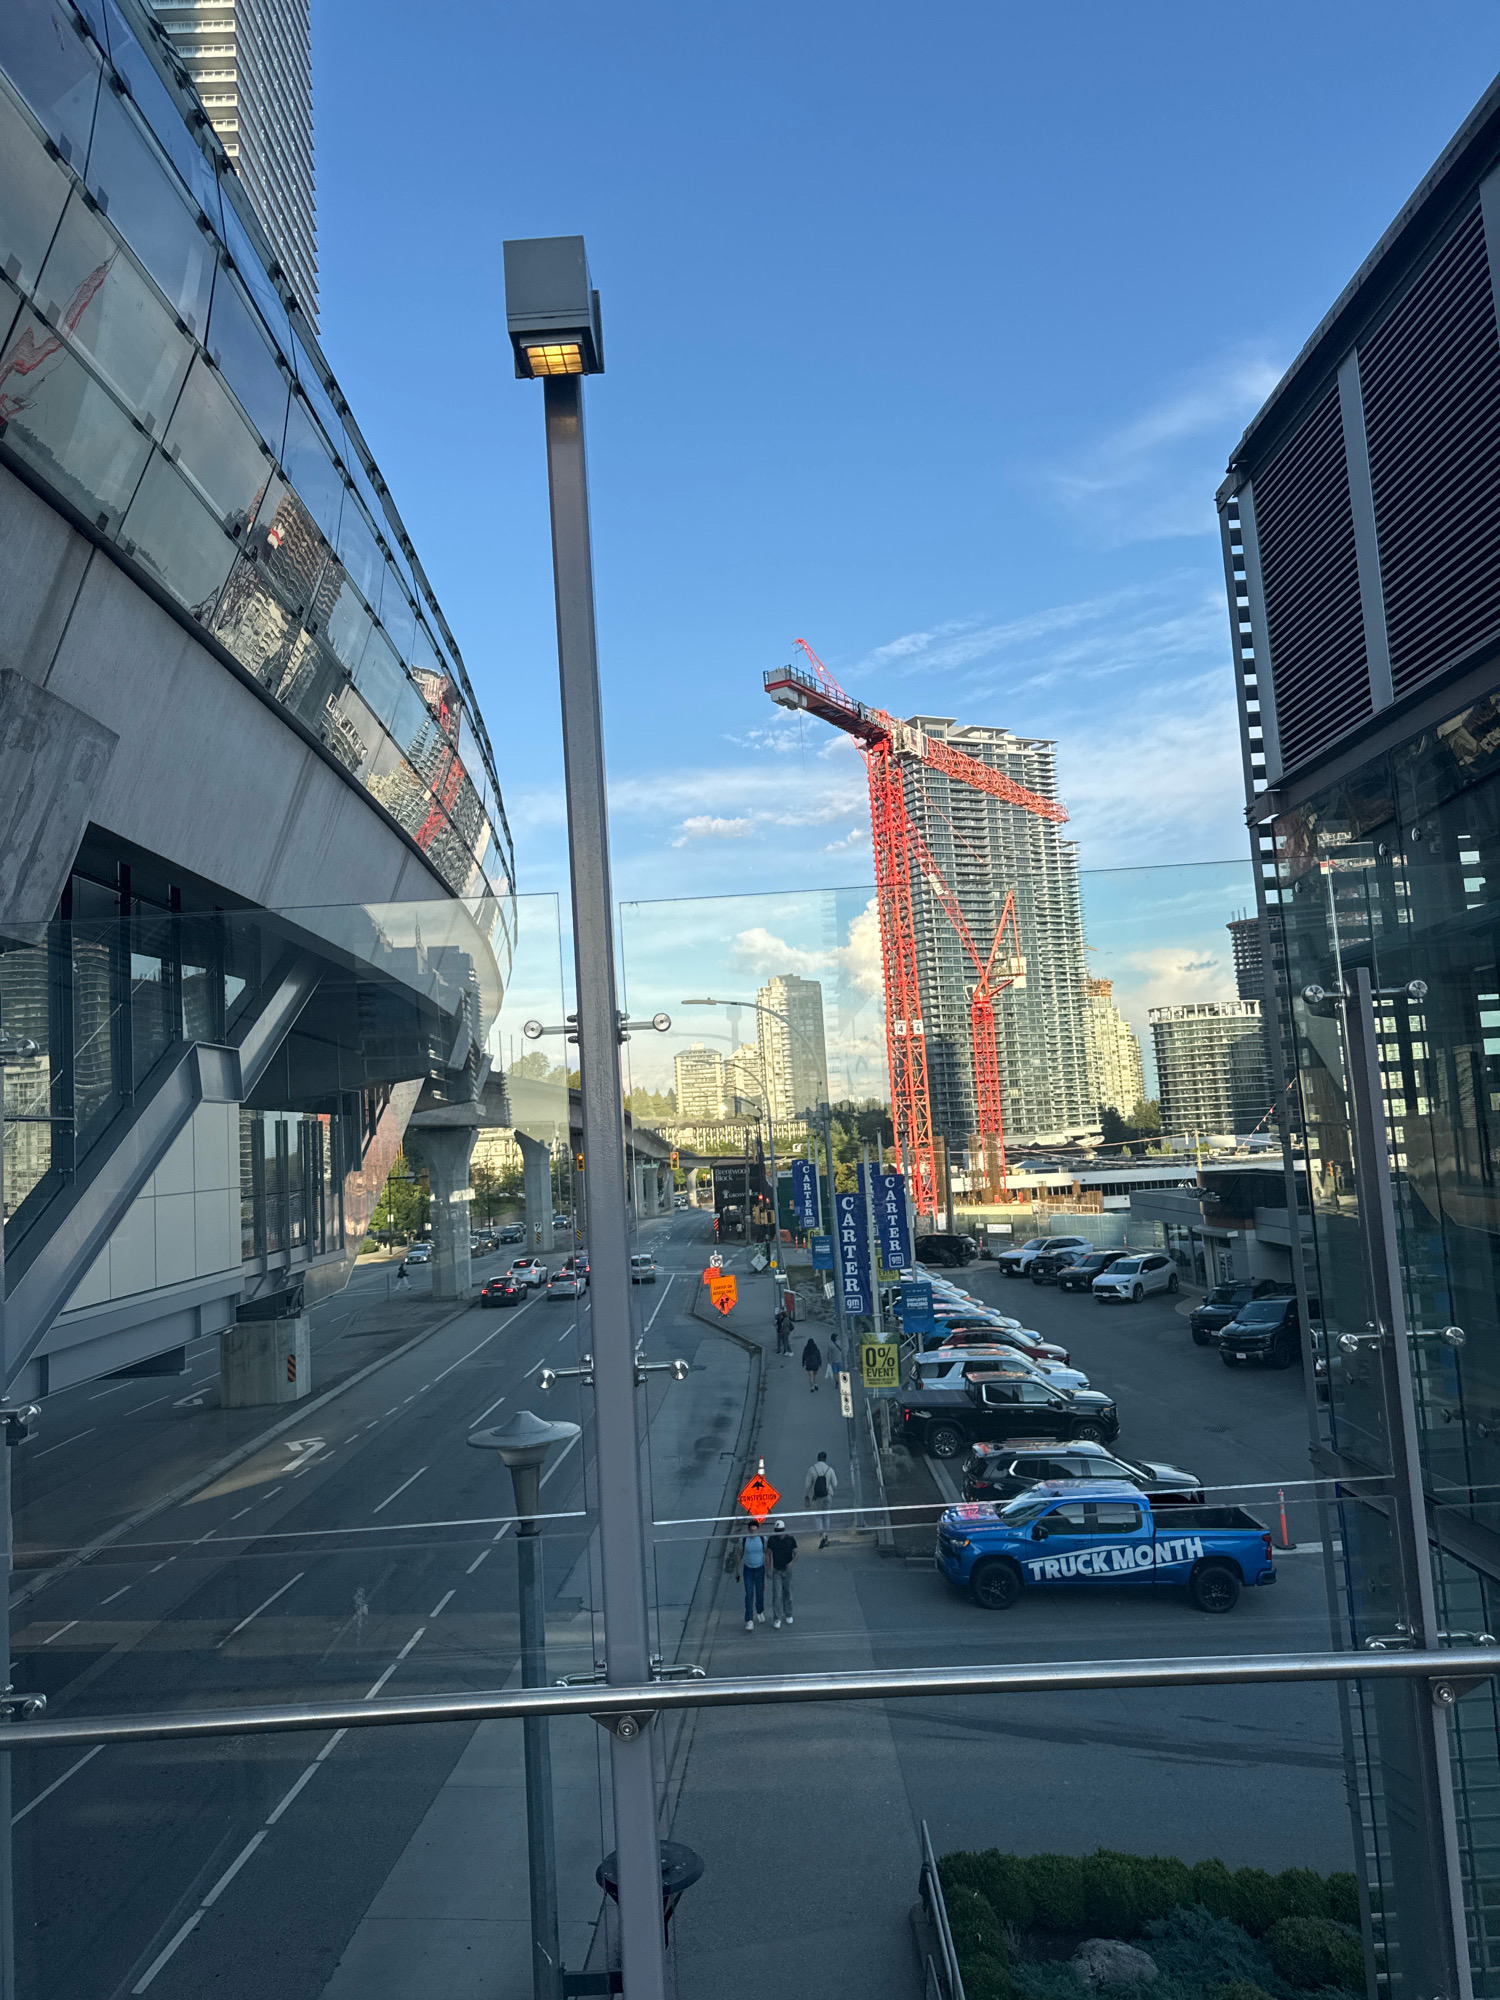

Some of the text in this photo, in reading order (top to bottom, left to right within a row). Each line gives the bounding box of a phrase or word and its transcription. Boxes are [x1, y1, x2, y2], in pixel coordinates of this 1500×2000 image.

[803, 1166, 813, 1216] CARTER
[884, 1177, 901, 1251] CARTER
[841, 1197, 860, 1292] CARTER
[891, 1256, 902, 1265] gm
[846, 1299, 860, 1309] gm
[865, 1347, 895, 1368] 0%
[866, 1367, 895, 1378] EVENT
[740, 1493, 777, 1502] CONSTRUCTION
[1028, 1536, 1205, 1581] TRUCK MONTH
